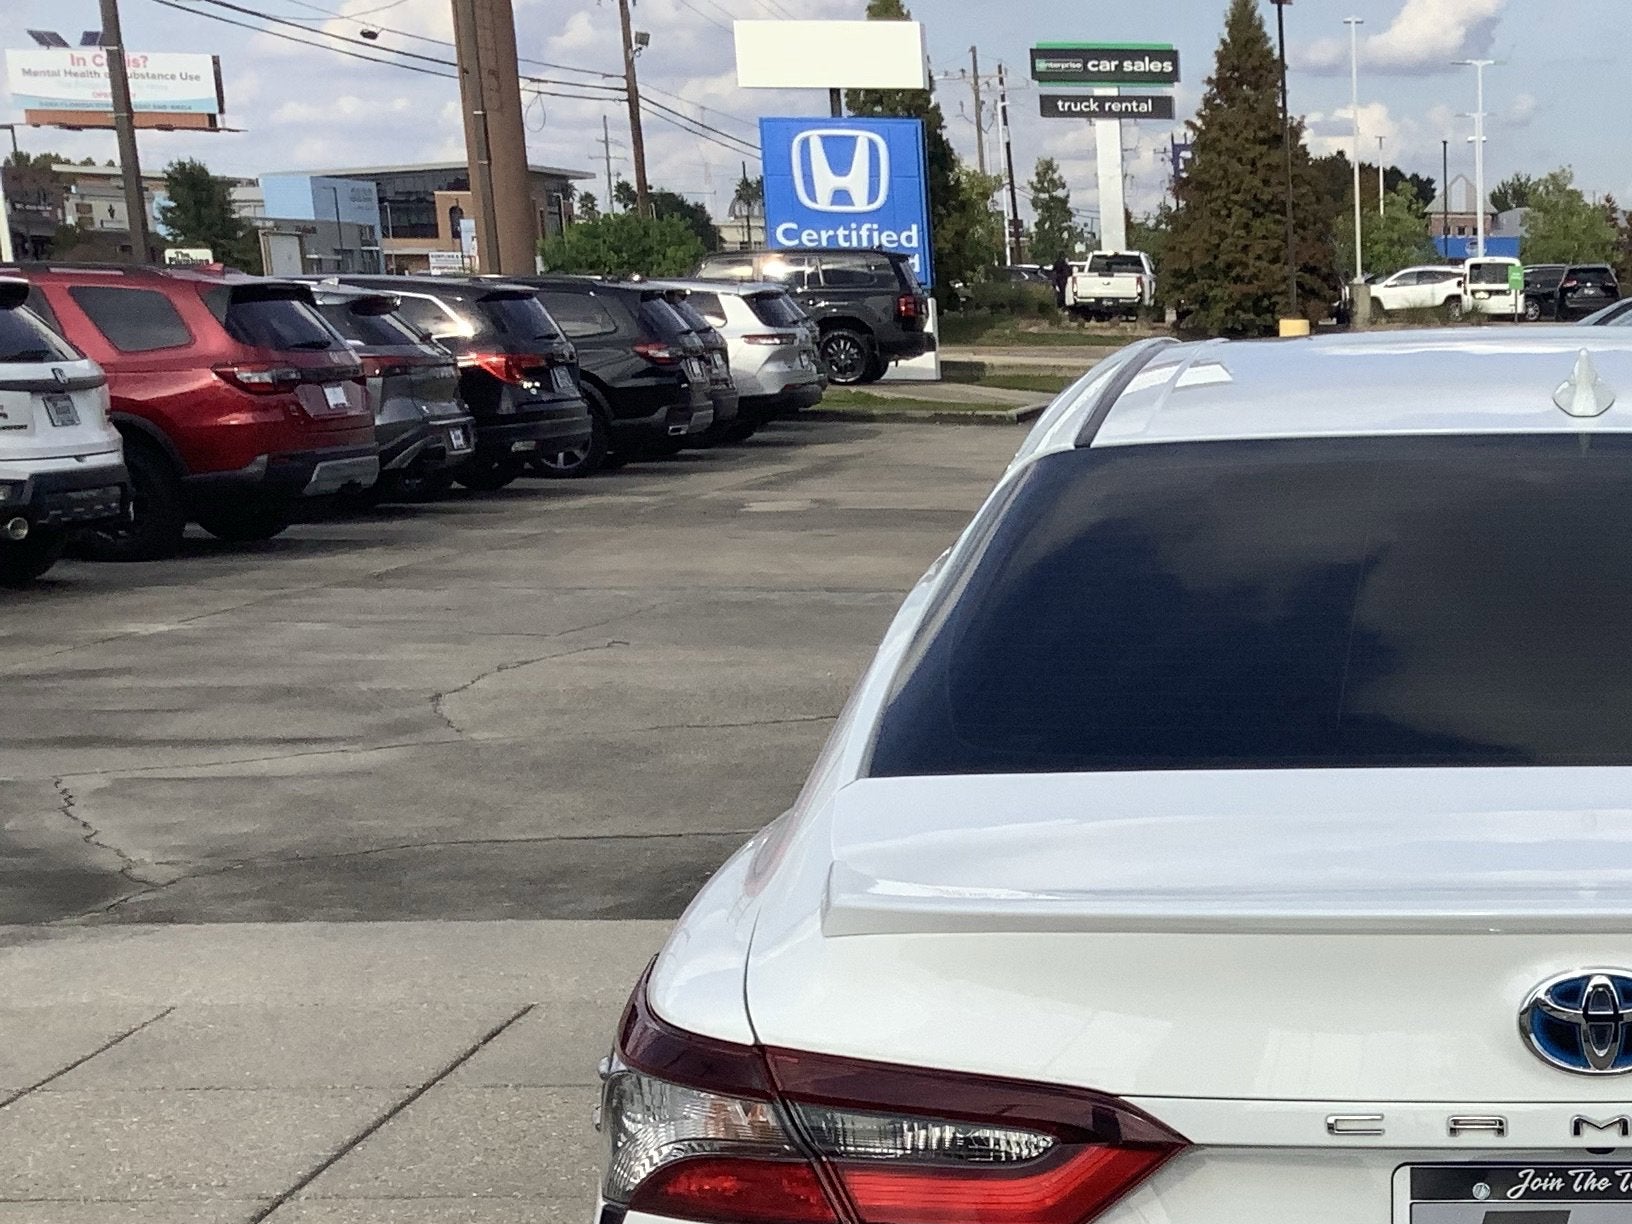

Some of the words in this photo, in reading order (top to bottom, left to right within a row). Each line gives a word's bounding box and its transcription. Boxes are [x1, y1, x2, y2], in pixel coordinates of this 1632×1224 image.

[70, 53, 87, 67] In
[92, 54, 149, 69] Cis?
[1087, 59, 1119, 72] car
[1123, 56, 1174, 72] sales
[21, 68, 61, 78] Mental
[63, 69, 100, 79] Health
[127, 72, 177, 81] ubstance
[179, 72, 201, 82] Use
[1056, 98, 1100, 112] truck
[1104, 98, 1153, 112] rental
[775, 222, 919, 248] Certified
[1506, 1169, 1565, 1199] Join
[1568, 1169, 1612, 1193] The
